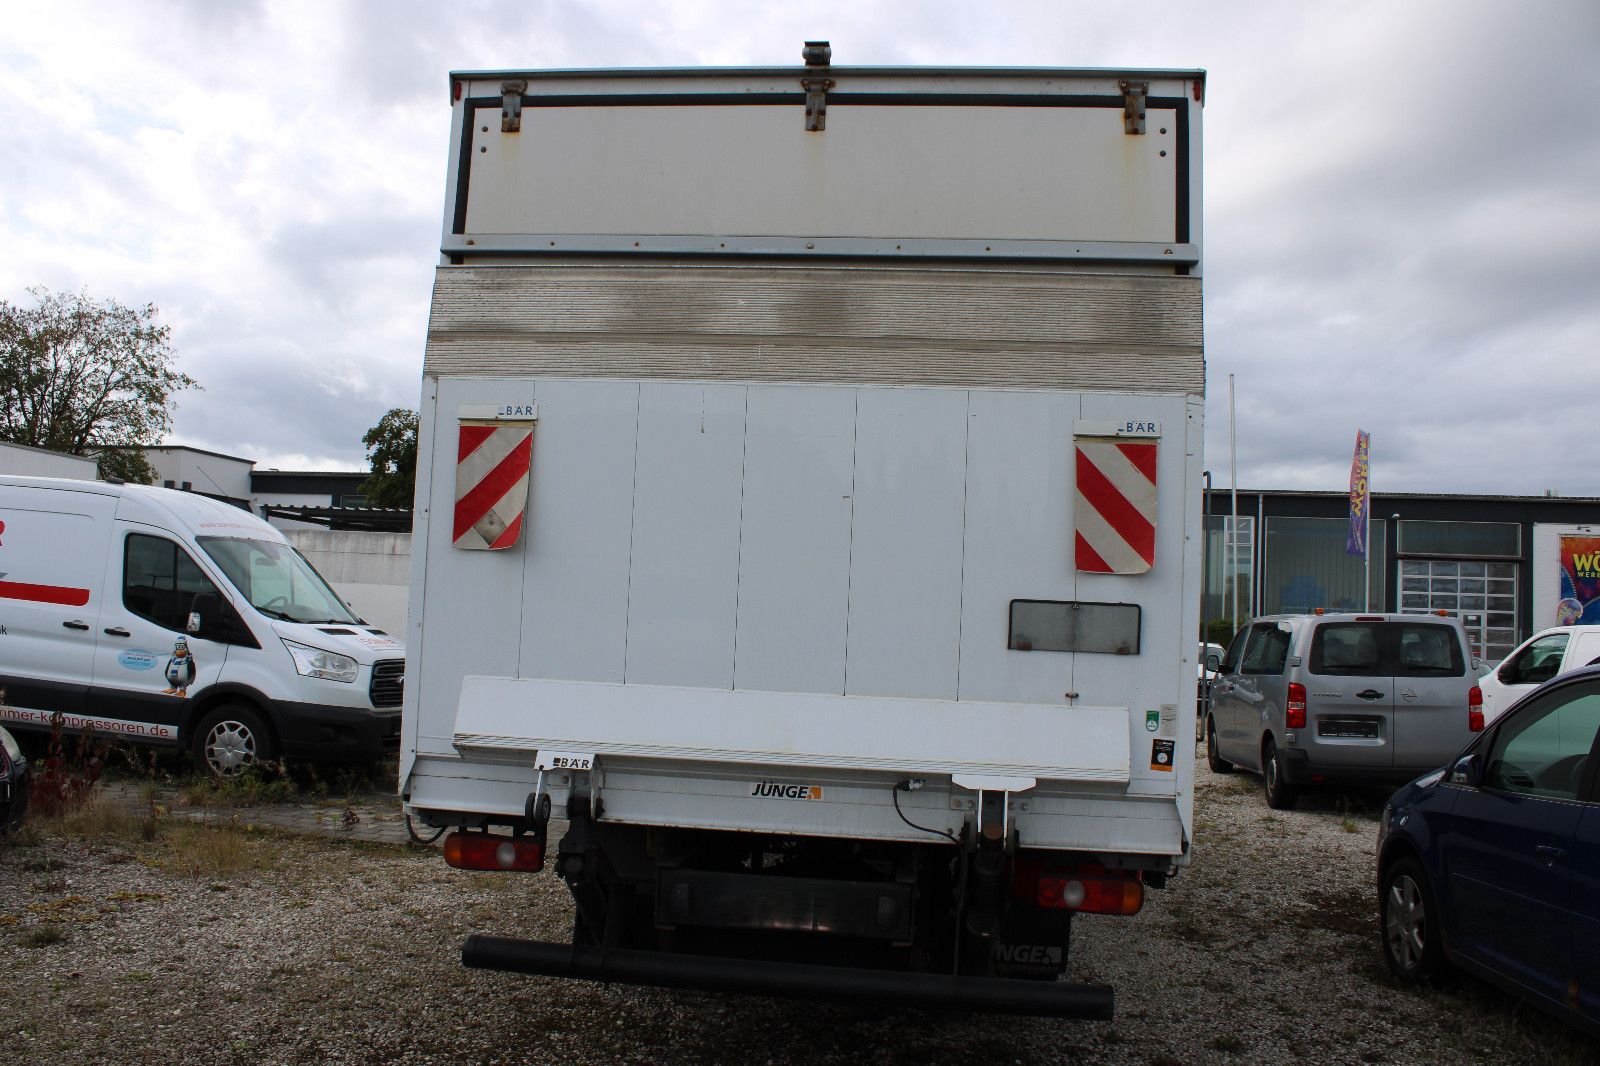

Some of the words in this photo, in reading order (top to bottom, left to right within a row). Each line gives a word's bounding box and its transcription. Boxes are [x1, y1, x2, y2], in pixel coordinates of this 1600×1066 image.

[506, 405, 533, 416] BÄR
[1126, 422, 1156, 433] BÄR
[560, 757, 590, 769] BÄR
[751, 781, 809, 799] JÜNGE
